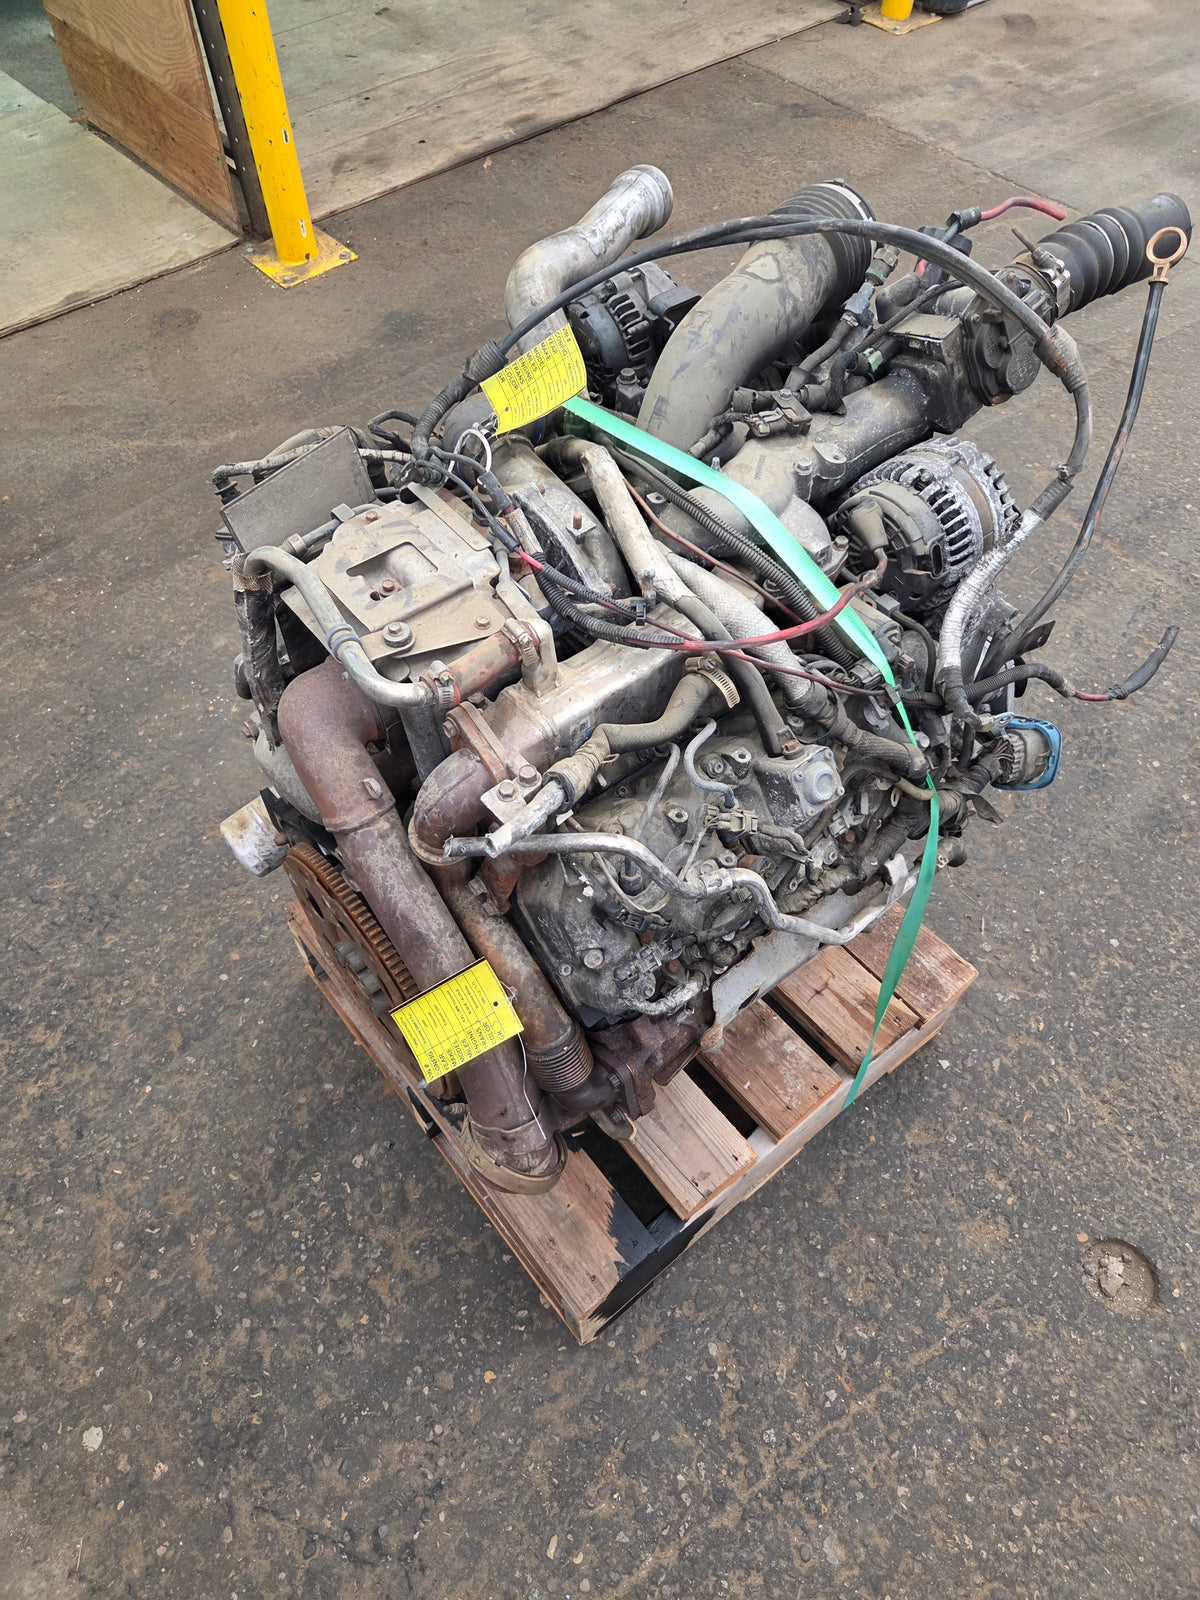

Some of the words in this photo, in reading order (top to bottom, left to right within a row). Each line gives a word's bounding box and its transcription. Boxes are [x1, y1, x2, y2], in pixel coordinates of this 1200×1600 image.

[541, 343, 551, 361] MAKE
[548, 338, 558, 354] YEAR
[555, 332, 567, 356] CONFIG
[519, 358, 534, 381] ENGINE
[526, 353, 537, 372] MILES
[534, 348, 545, 371] MODEL
[497, 374, 505, 383] GR
[505, 368, 518, 390] COLOR
[511, 363, 525, 385] TRANS
[467, 1029, 481, 1054] ENGINE
[476, 1027, 487, 1048] TRANS
[482, 1022, 495, 1044] COLOR
[497, 1030, 504, 1040] GR
[446, 1048, 457, 1067] MAKE
[453, 1039, 465, 1062] MODEL
[461, 1039, 473, 1058] MILES
[428, 1051, 442, 1075] CONFIG
[439, 1054, 449, 1071] YEAR
[426, 1068, 434, 1080] VIN
